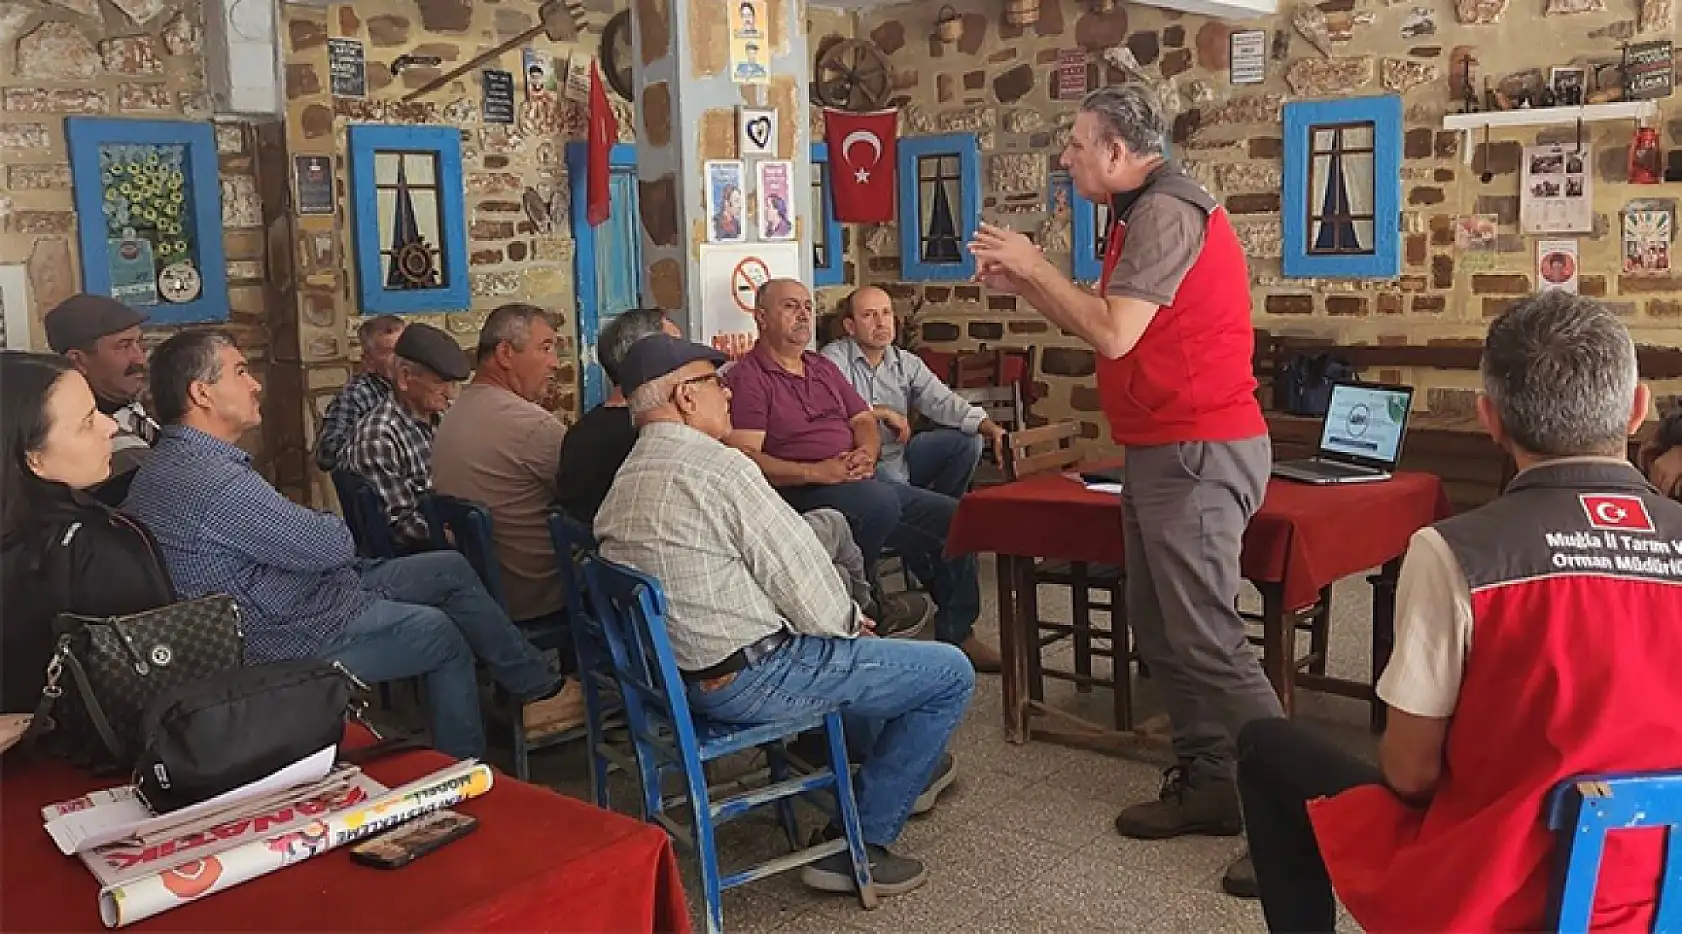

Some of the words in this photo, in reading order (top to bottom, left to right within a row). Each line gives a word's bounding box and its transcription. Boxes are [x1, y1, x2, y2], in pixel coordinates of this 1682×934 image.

[1545, 530, 1602, 549] Muğla
[1620, 535, 1671, 554] Tarım
[1552, 553, 1612, 569] Orman
